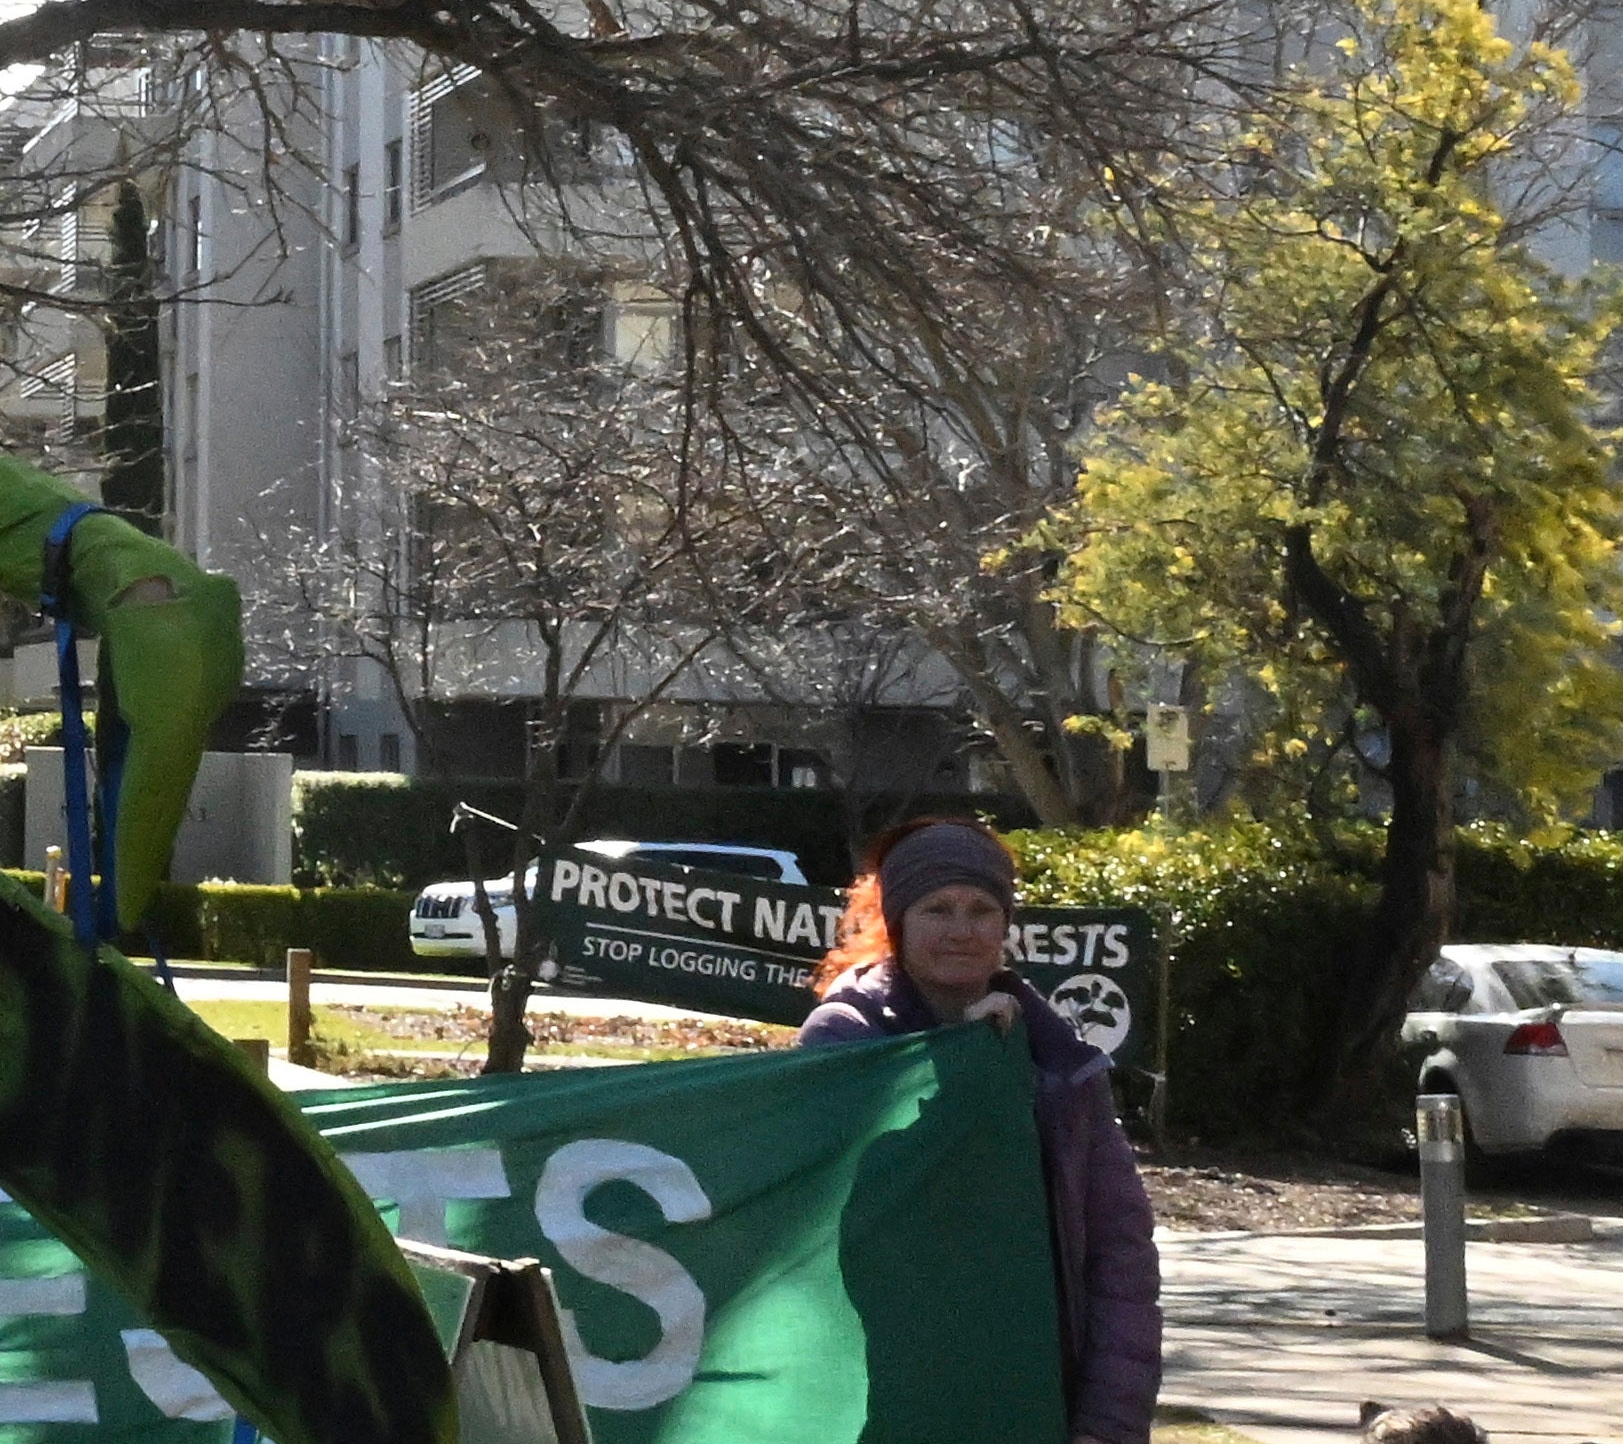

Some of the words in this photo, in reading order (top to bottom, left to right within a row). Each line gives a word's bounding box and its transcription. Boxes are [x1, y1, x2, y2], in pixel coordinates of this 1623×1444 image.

[551, 859, 742, 933] PROTECT
[581, 935, 643, 963] STOP
[648, 947, 757, 981] LOGGING
[764, 963, 810, 989] THE
